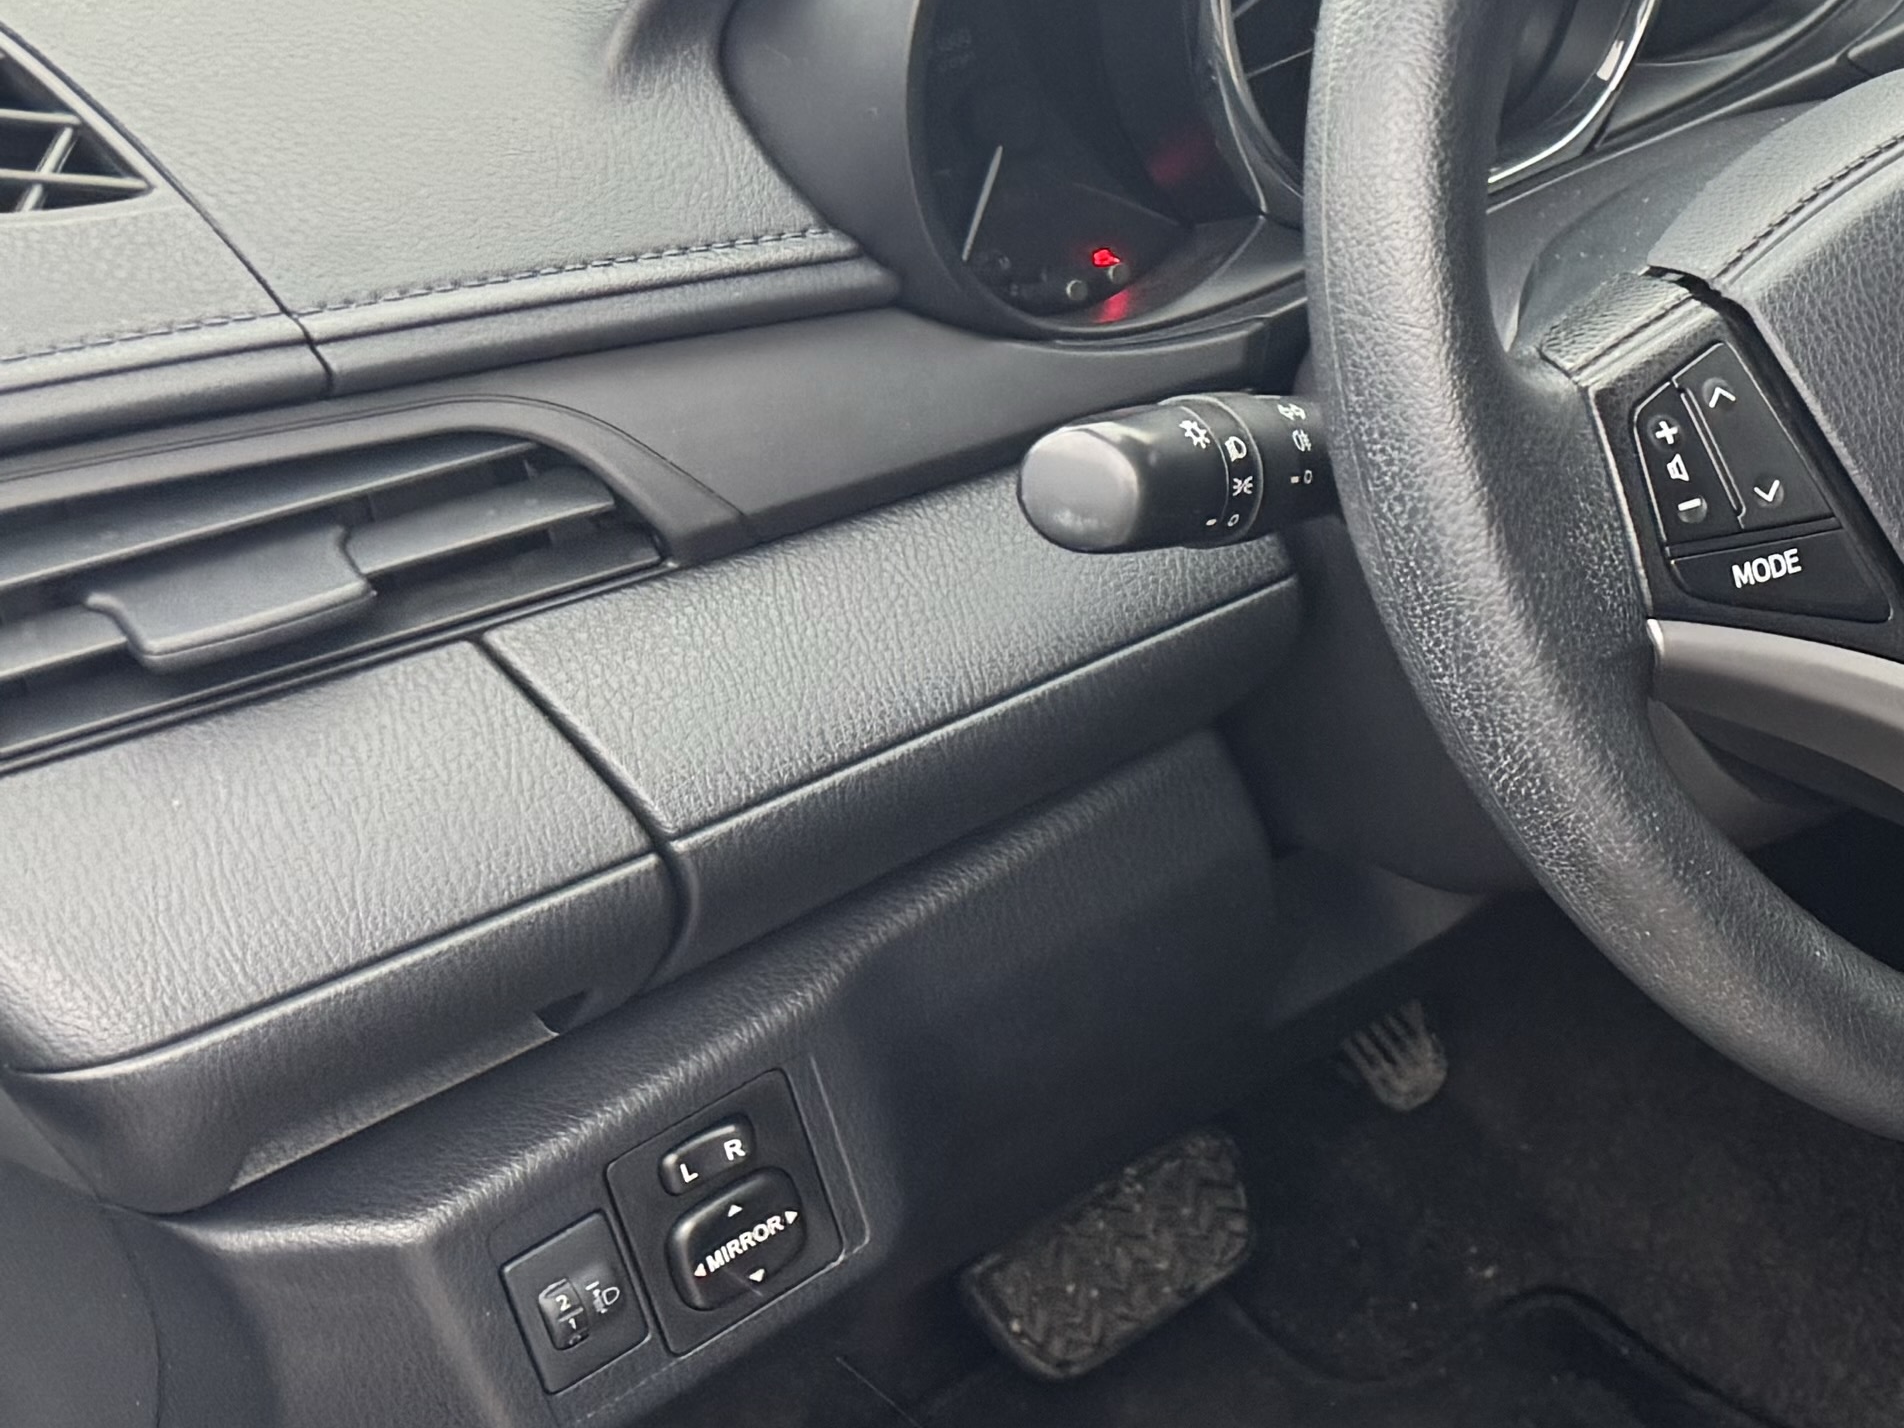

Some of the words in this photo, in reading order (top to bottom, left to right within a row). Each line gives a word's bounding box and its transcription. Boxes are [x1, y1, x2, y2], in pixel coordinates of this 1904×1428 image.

[1731, 548, 1803, 588] MODE
[680, 1163, 699, 1183] L
[723, 1139, 746, 1161] R
[705, 1215, 785, 1273] MIRROR
[555, 1294, 572, 1312] 2
[568, 1317, 577, 1330] 1
